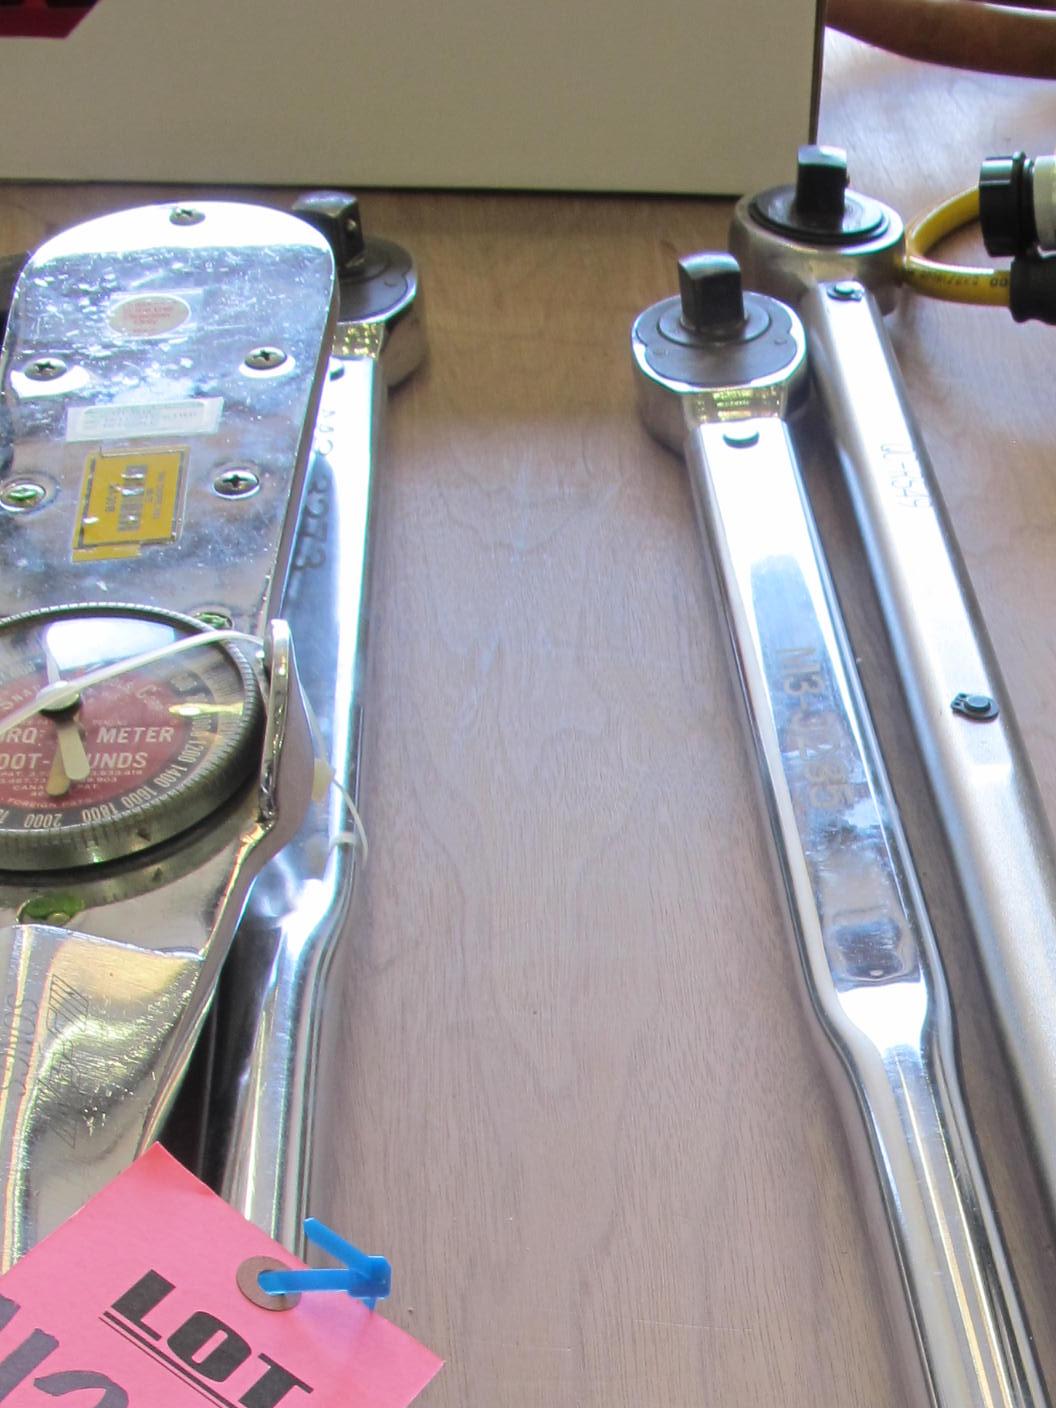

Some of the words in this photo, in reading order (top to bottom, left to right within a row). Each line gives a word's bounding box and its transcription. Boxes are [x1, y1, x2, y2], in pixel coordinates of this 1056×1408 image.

[97, 727, 175, 744] METER
[154, 764, 187, 788] 1400
[121, 785, 158, 807] 1600
[24, 812, 63, 828] 2000
[82, 804, 117, 824] 1800
